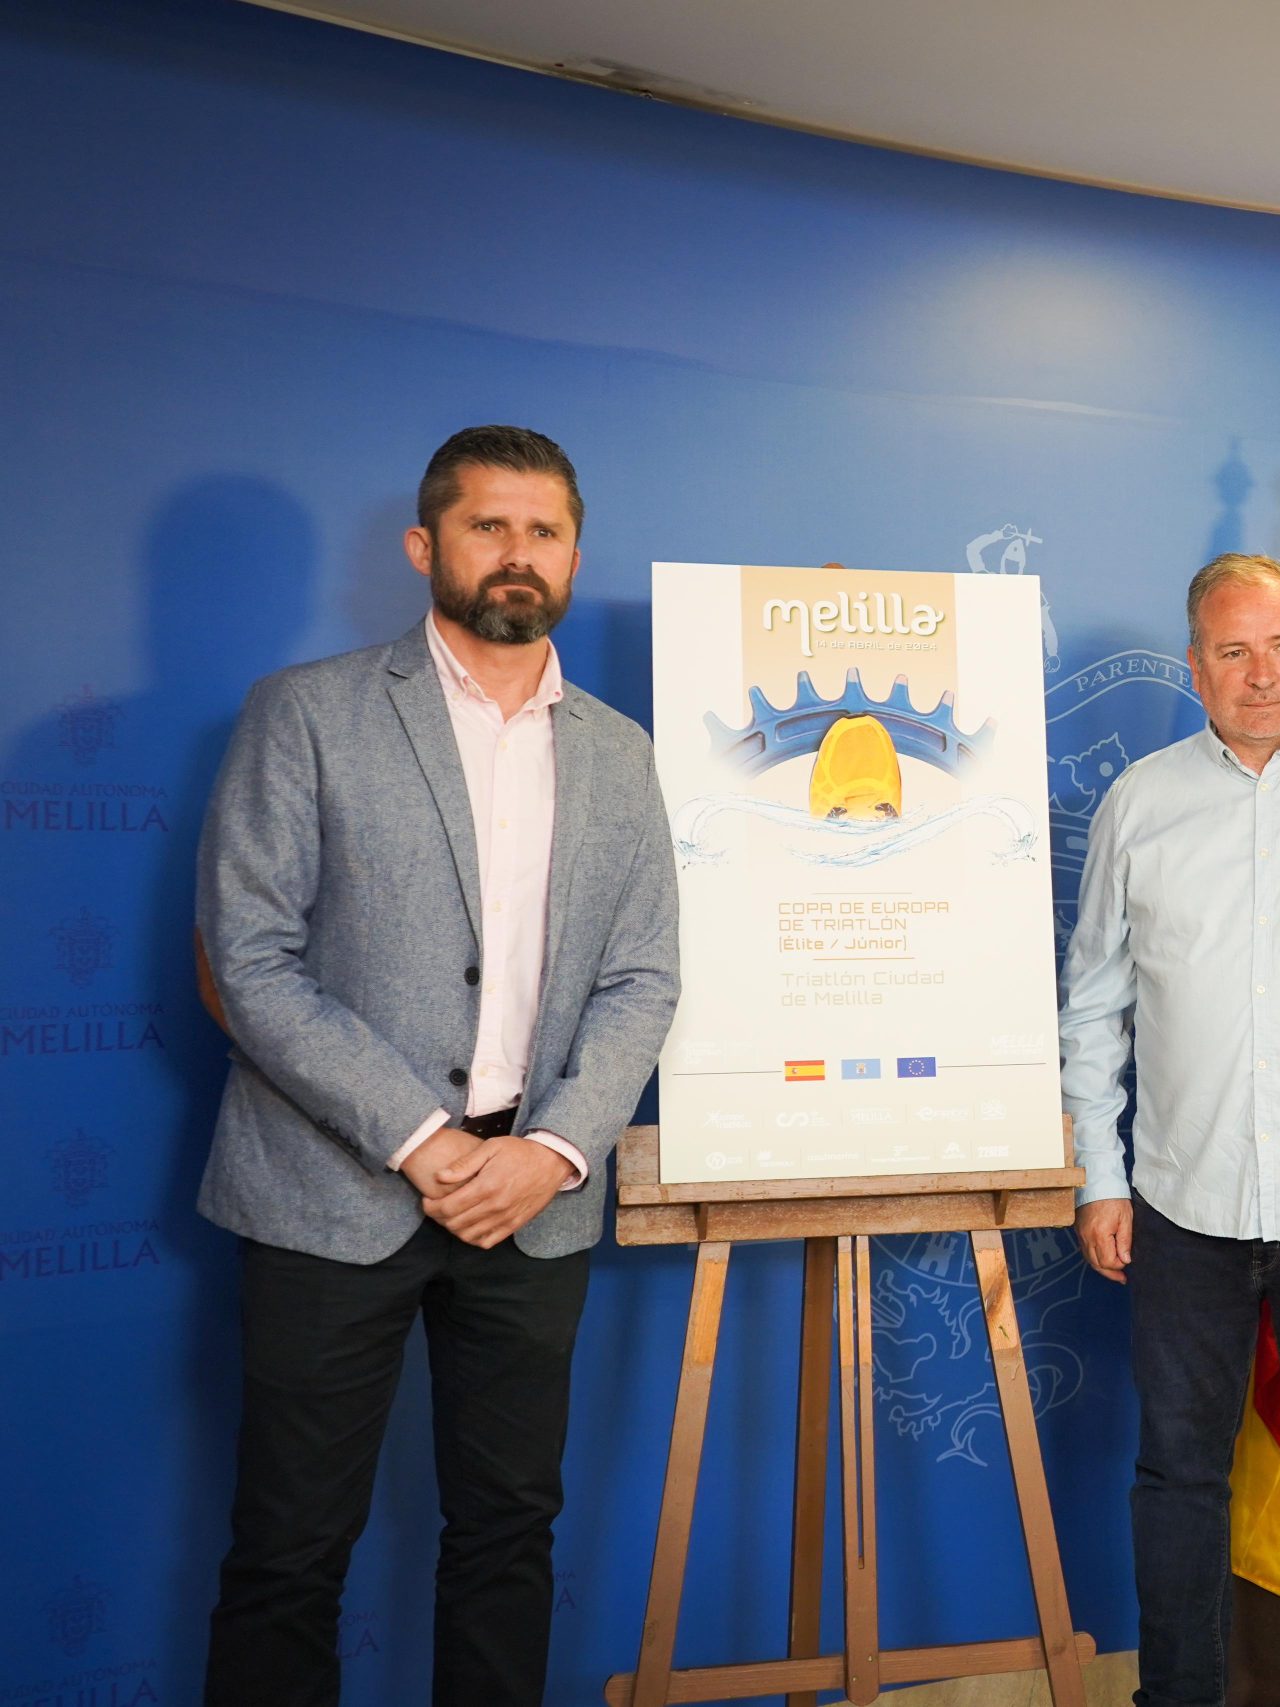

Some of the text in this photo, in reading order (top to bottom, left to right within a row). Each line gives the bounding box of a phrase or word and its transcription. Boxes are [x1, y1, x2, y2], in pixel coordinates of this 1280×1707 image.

[763, 591, 945, 657] melilla
[816, 640, 937, 651] 14 de ABRIL de 2024
[1074, 658, 1192, 692] PARENTE
[0, 781, 169, 799] CIUDAD AUTONOMA
[4, 800, 169, 832] MELILLA
[779, 902, 949, 915] COPA DE EUROPA
[779, 915, 907, 932] DE TRIATLÓN
[779, 936, 825, 953] (Élite
[845, 935, 907, 952] Júnior)
[781, 970, 945, 988] Triatlón Ciudad
[781, 990, 883, 1007] de Melilla
[1, 1020, 165, 1056] MELILLA
[0, 1236, 160, 1281] MELILLA
